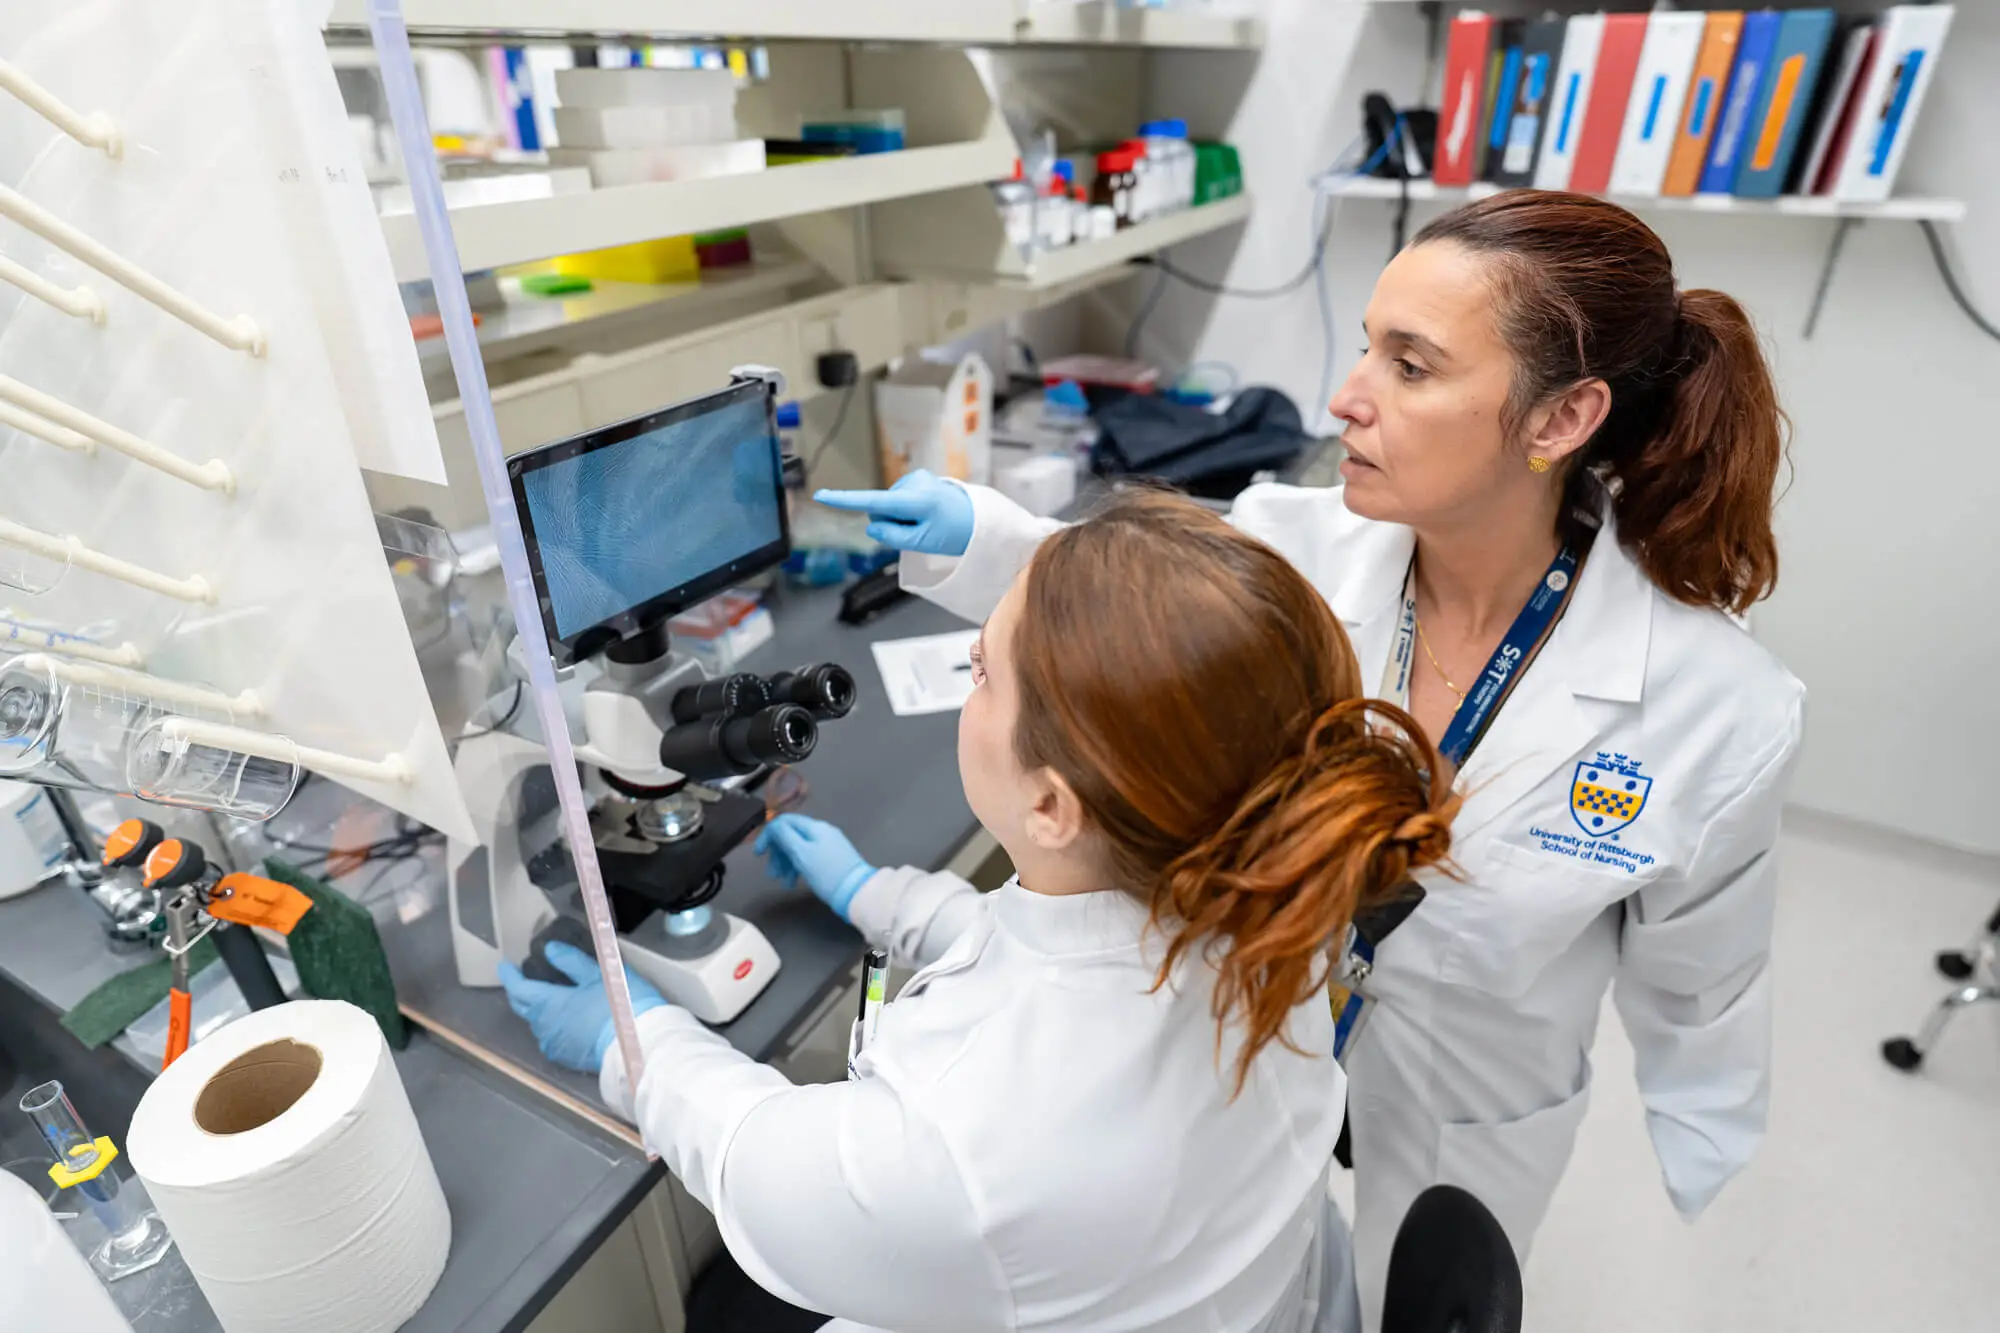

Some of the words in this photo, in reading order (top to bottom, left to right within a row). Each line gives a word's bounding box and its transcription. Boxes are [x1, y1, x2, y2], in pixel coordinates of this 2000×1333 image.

[1529, 826, 1583, 847] University
[1584, 840, 1597, 850] of
[1597, 841, 1655, 865] Pittsburgh
[1540, 840, 1578, 857] School
[1580, 850, 1592, 861] of
[1593, 853, 1637, 873] Nursing
